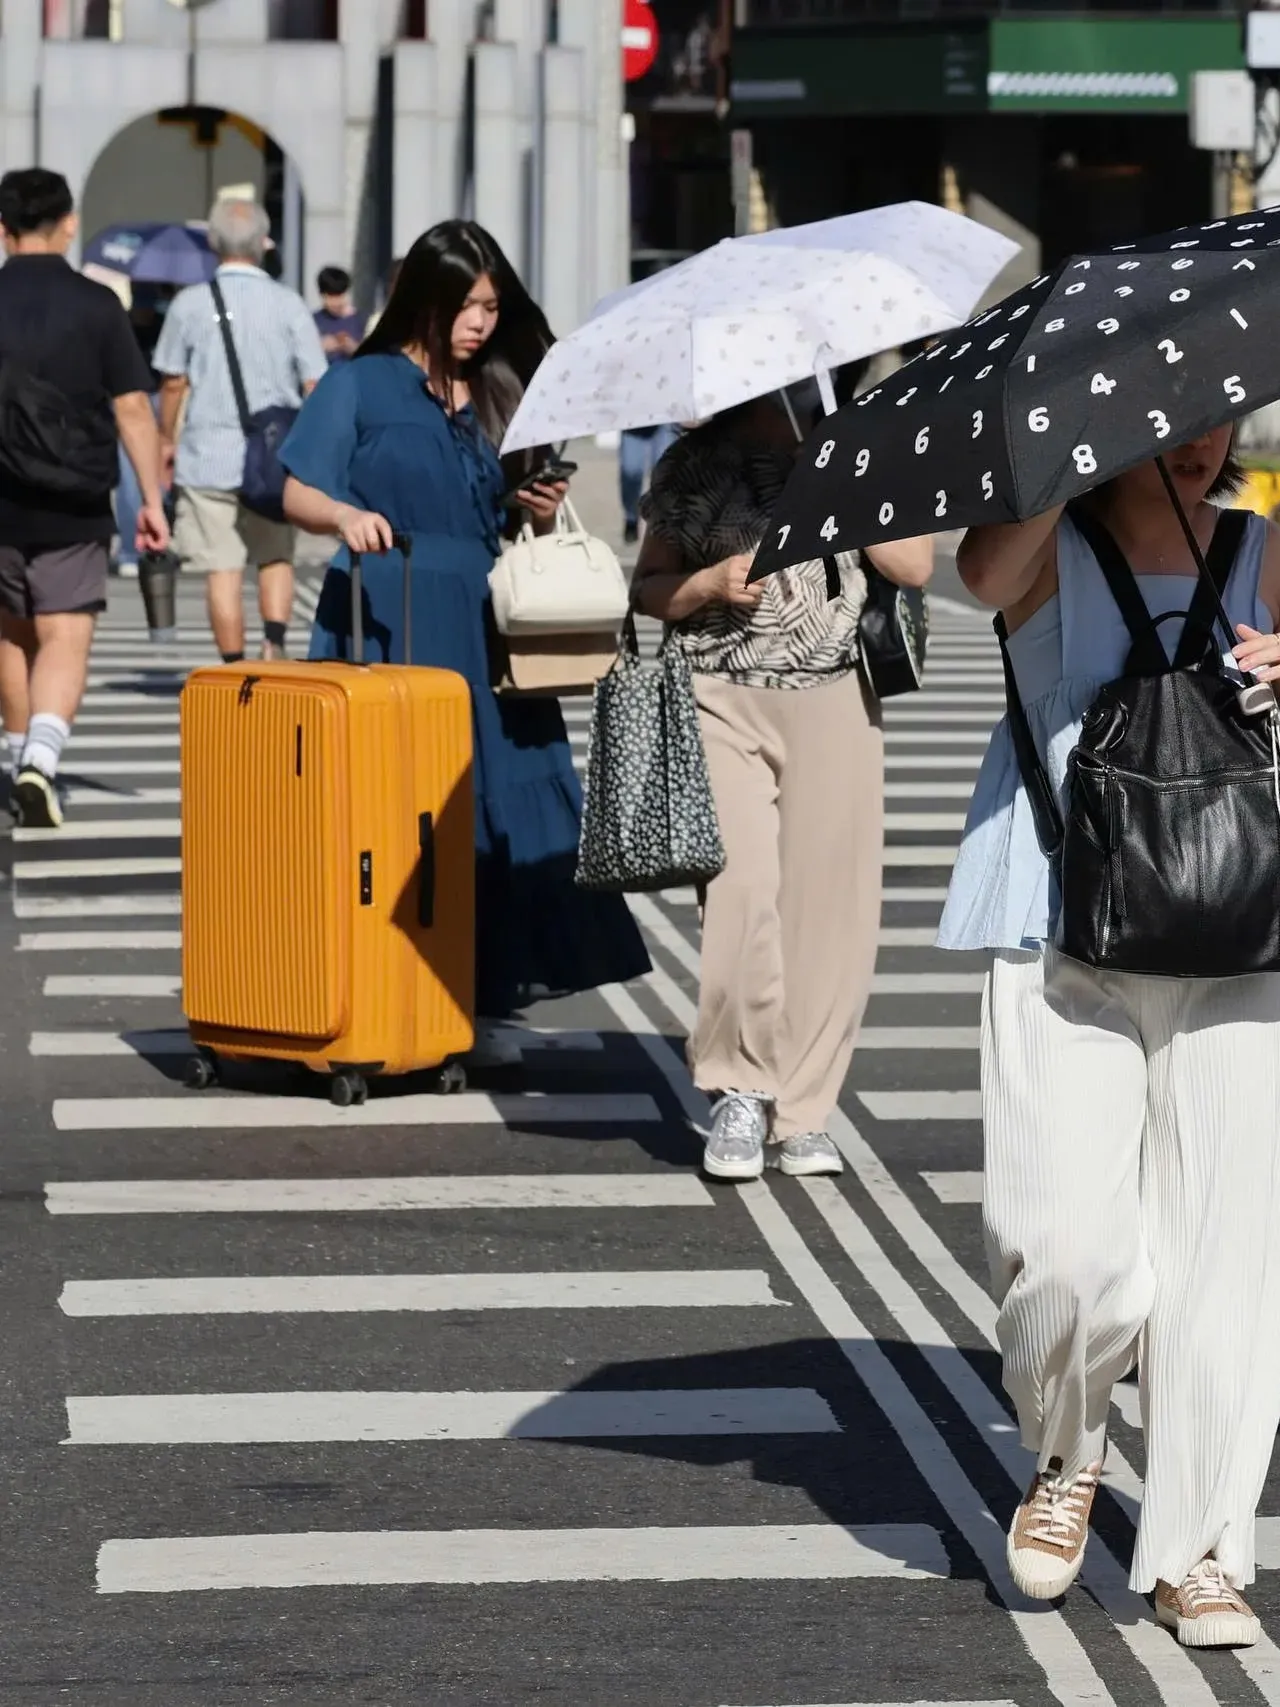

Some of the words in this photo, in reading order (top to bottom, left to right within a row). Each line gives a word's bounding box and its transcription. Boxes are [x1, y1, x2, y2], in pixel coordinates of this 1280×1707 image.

[1064, 281, 1087, 296] 0
[1168, 287, 1191, 303] 0
[1044, 317, 1065, 334] 8
[1096, 317, 1120, 335] 9
[1229, 307, 1249, 331] 1
[1157, 338, 1185, 364] 2
[974, 364, 994, 380] 0
[1090, 372, 1117, 396] 4
[895, 386, 918, 406] 2
[1222, 374, 1247, 404] 5
[971, 409, 983, 439] 3
[1027, 406, 1050, 433] 6
[1147, 409, 1171, 439] 3
[815, 439, 836, 469] 8
[914, 426, 930, 455] 6
[854, 448, 871, 477] 9
[1071, 443, 1098, 475] 8
[981, 470, 994, 501] 5
[878, 502, 894, 526] 0
[935, 489, 947, 517] 2
[819, 515, 839, 542] 4
